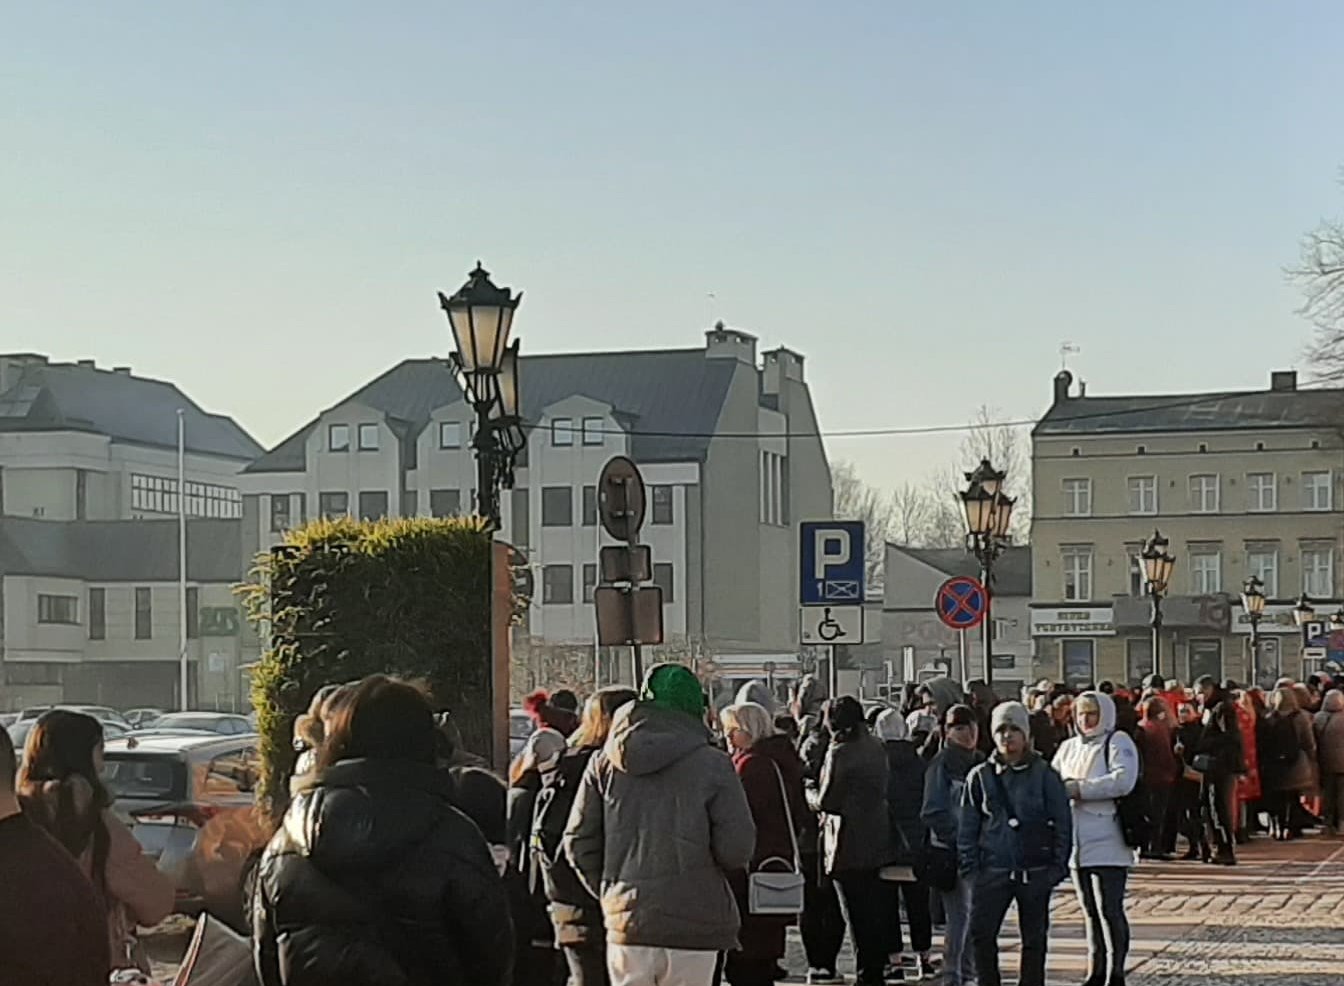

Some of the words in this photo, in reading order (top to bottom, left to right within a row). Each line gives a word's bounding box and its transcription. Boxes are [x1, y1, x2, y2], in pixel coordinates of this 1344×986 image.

[814, 528, 851, 580] P
[816, 581, 824, 598] 1
[199, 606, 241, 630] ZUS
[1307, 623, 1322, 640] P
